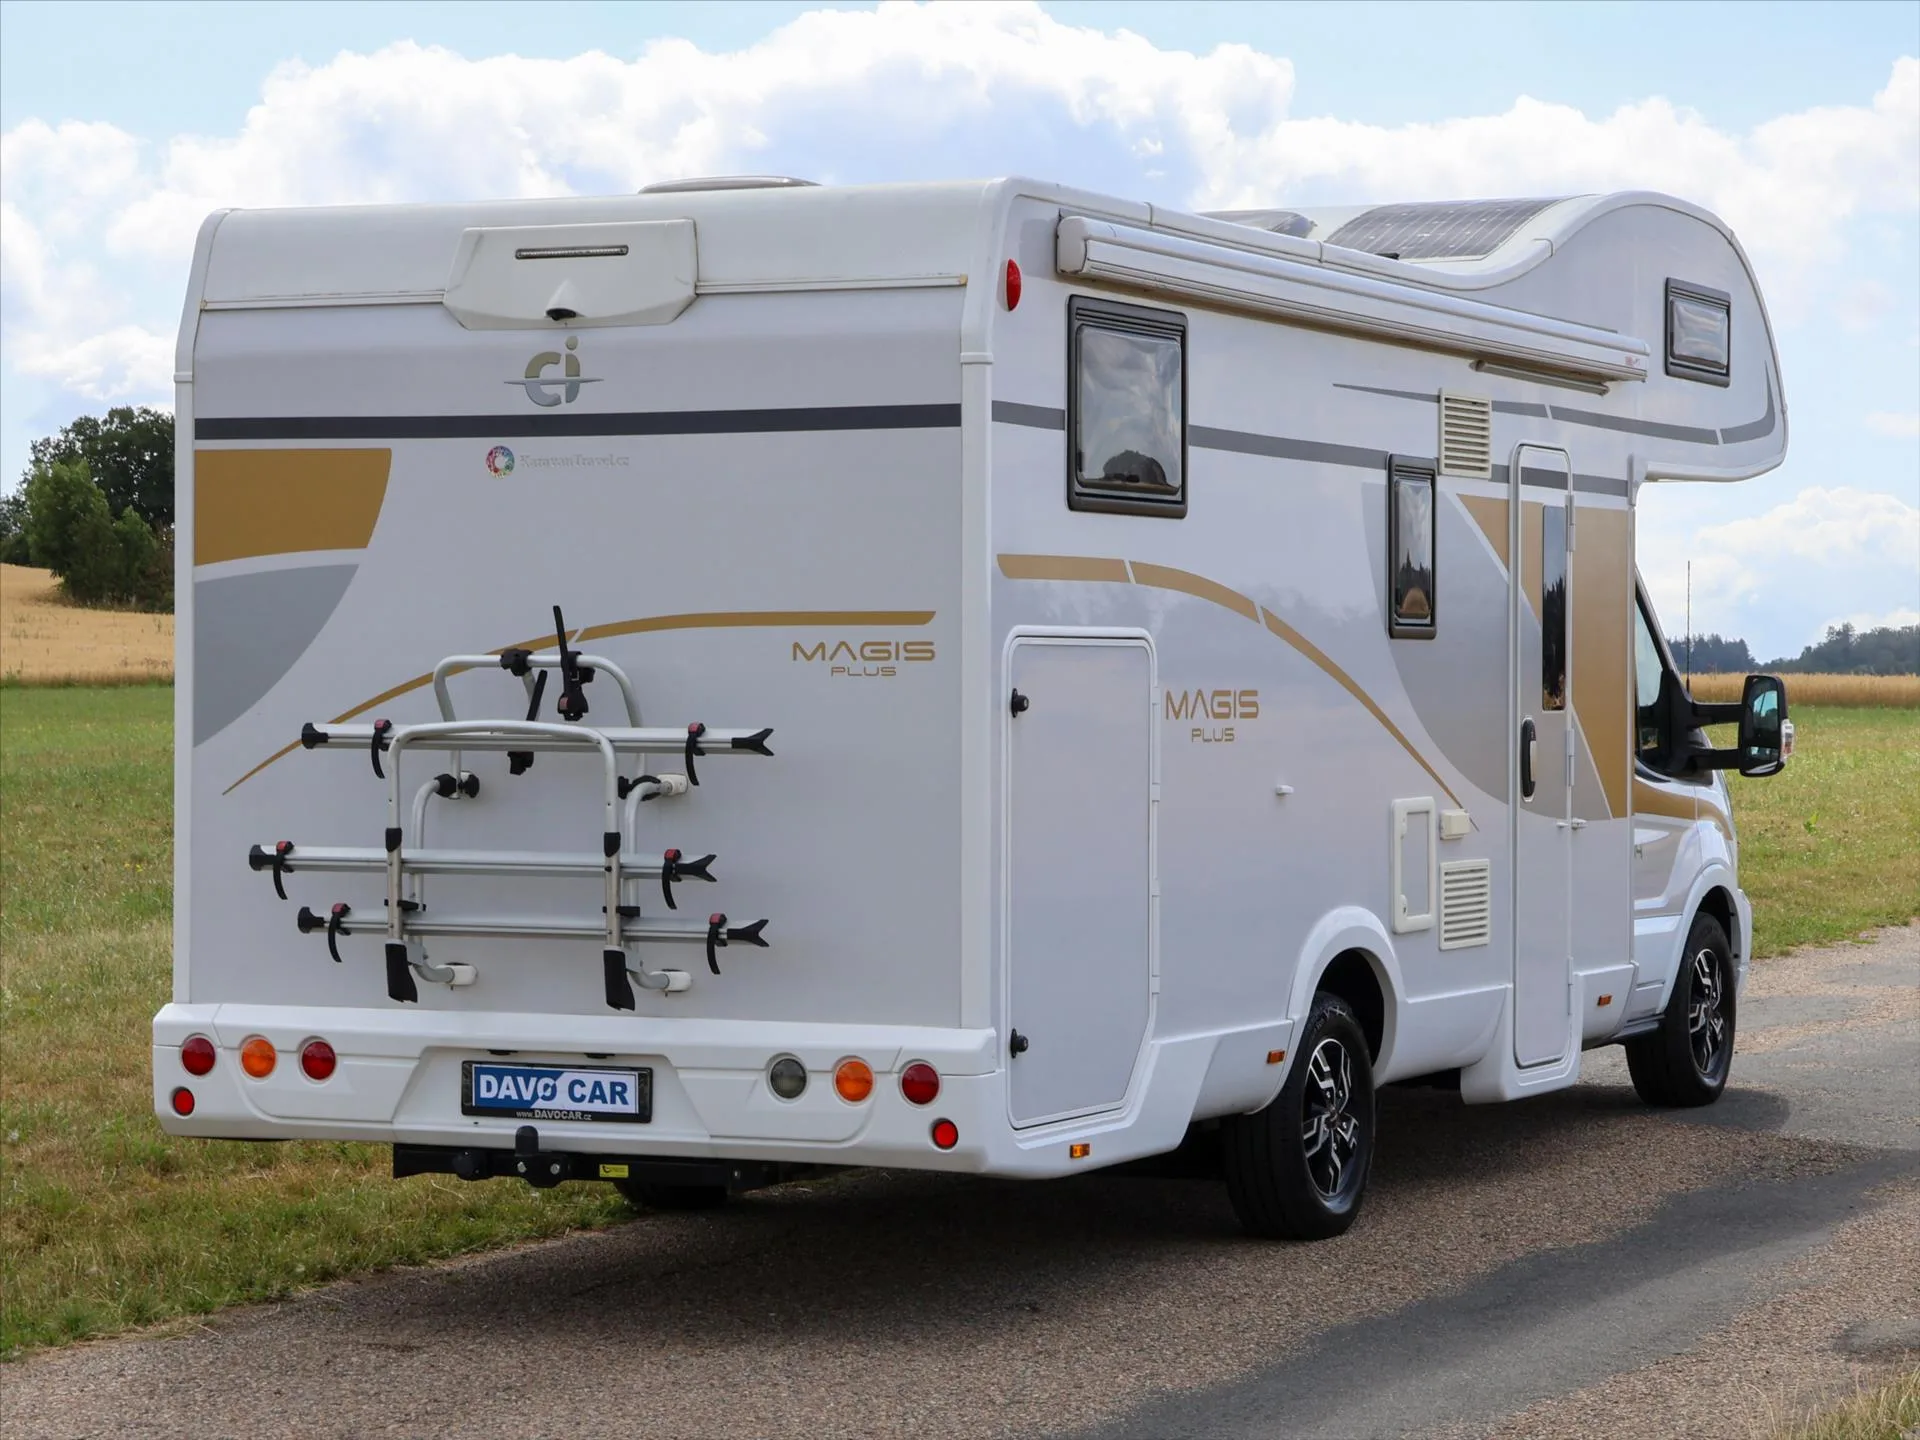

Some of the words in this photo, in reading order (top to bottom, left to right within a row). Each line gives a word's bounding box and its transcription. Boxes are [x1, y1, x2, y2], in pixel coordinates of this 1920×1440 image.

[792, 641, 936, 661] MAGIS
[831, 666, 897, 677] PLUS
[1166, 689, 1259, 720] MAGIS
[1191, 728, 1235, 742] PLUS
[480, 1074, 557, 1101] DAVO
[568, 1079, 629, 1105] CAR
[516, 1109, 592, 1121] www.DAVOCAR.cz
